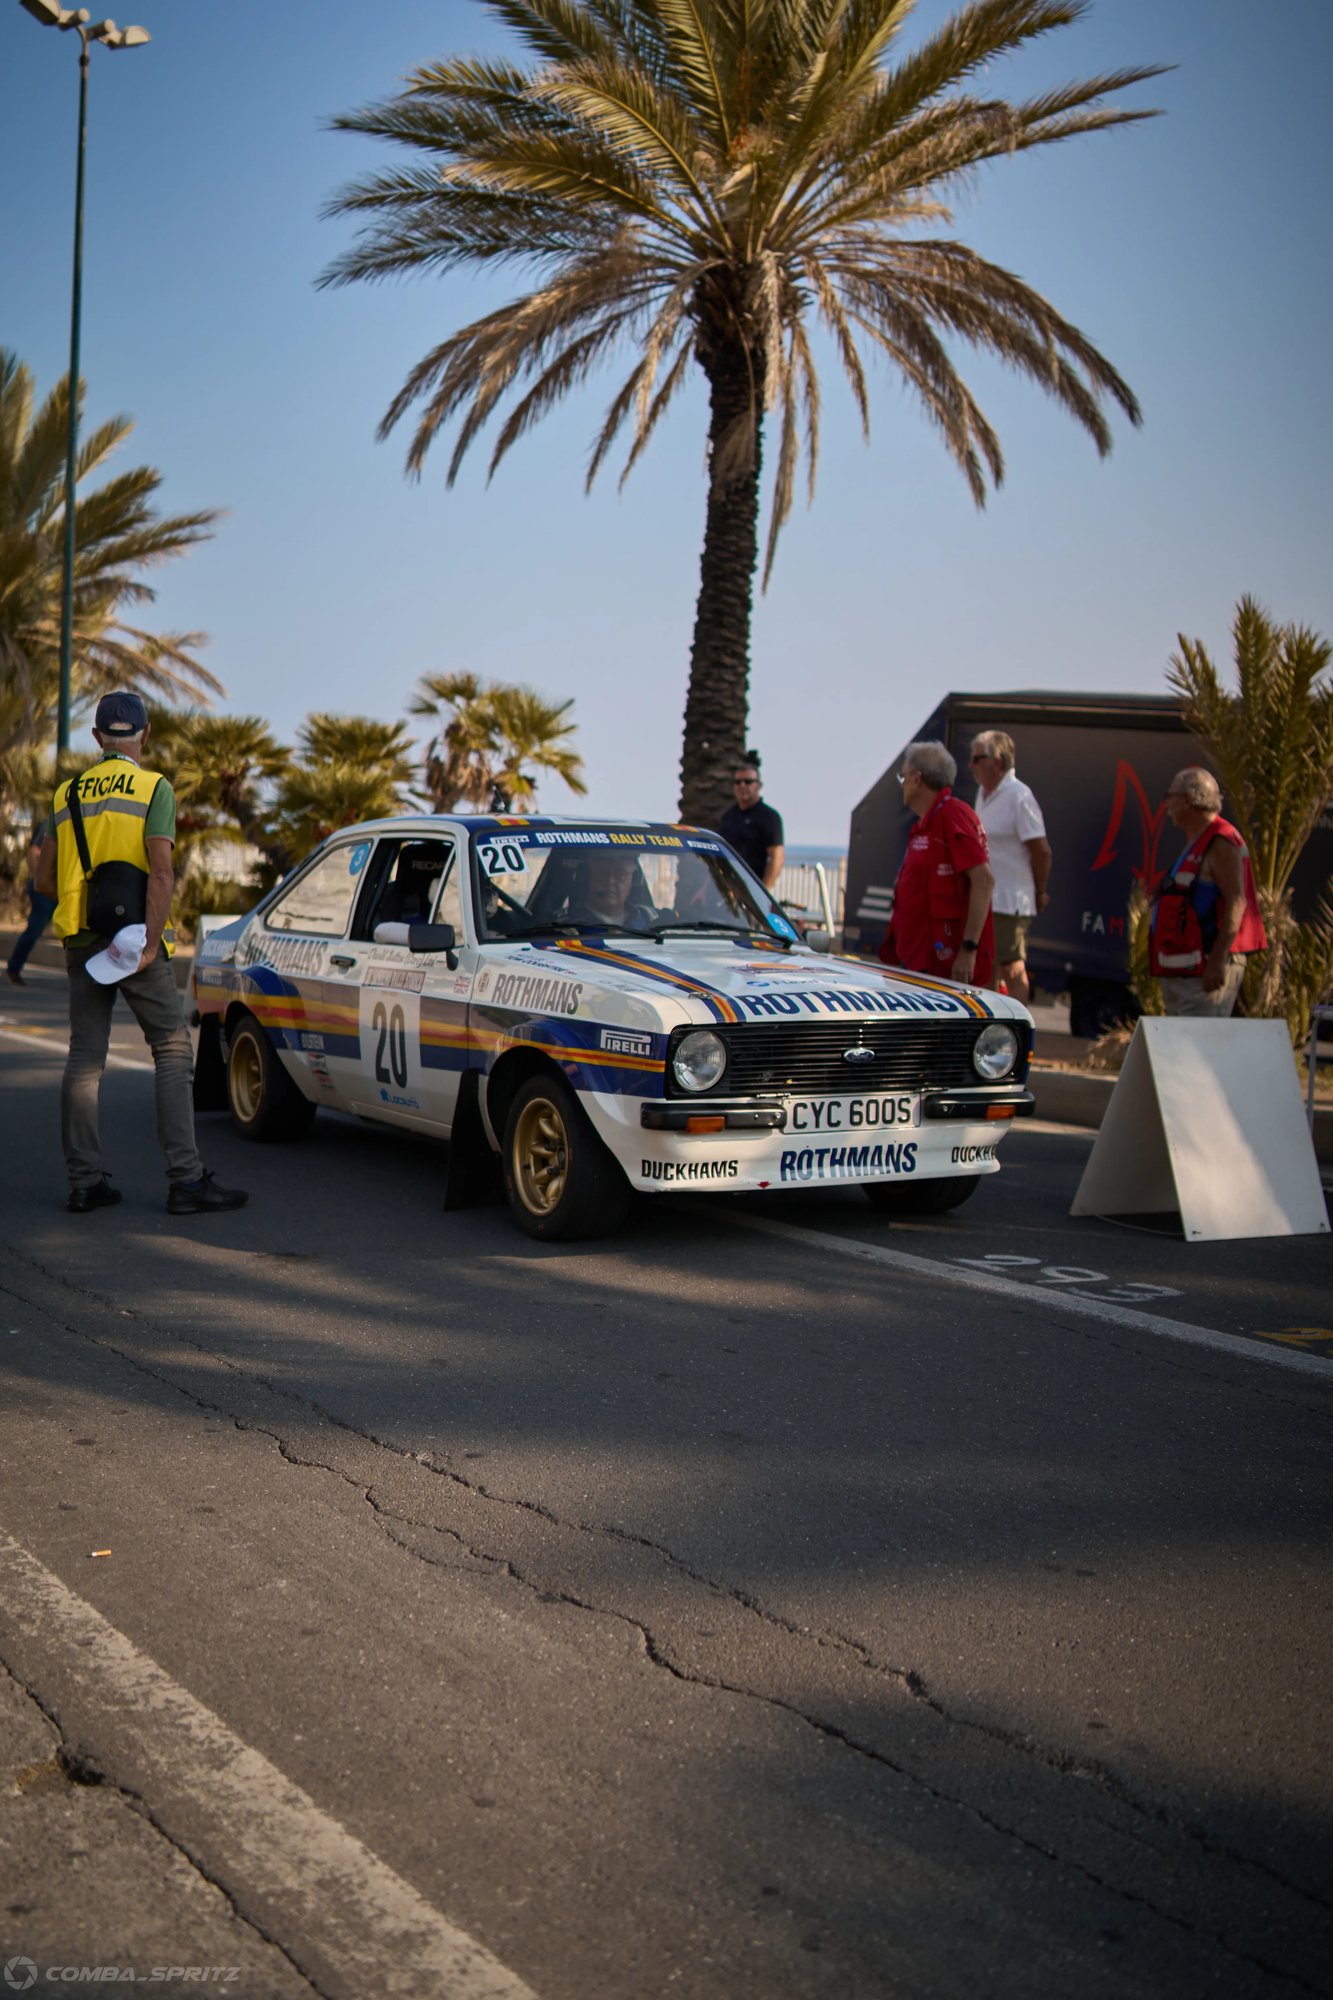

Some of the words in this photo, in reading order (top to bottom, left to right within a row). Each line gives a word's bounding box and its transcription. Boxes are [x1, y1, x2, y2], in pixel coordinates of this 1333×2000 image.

[535, 832, 610, 844] ROTHMANS
[610, 833, 646, 845] RALLY
[648, 835, 683, 847] TEAM
[411, 859, 443, 871] RECA
[482, 844, 526, 874] 20
[491, 974, 583, 1015] ROTHMANS
[736, 990, 959, 1017] ROTHMANS
[372, 1001, 408, 1088] 20
[600, 1029, 651, 1056] PIRELLI
[792, 1100, 842, 1129] CYC
[849, 1097, 912, 1126] 600S
[641, 1159, 738, 1181] DUCKHAMS
[780, 1142, 918, 1182] ROTHMANS
